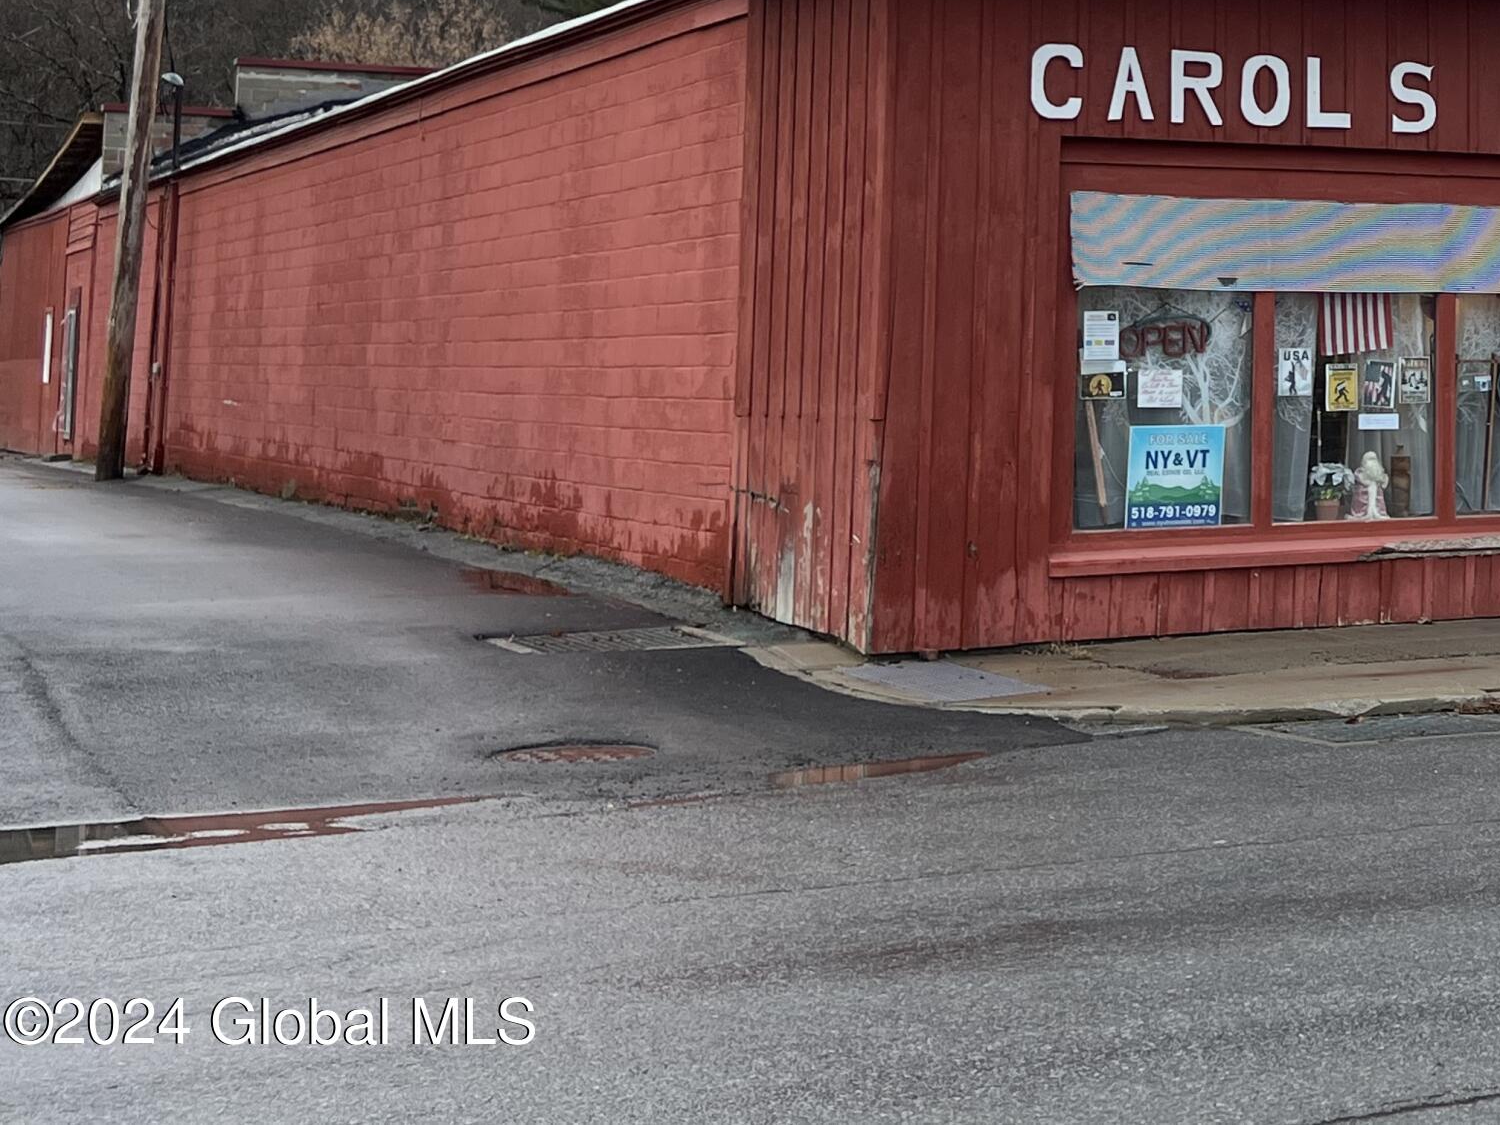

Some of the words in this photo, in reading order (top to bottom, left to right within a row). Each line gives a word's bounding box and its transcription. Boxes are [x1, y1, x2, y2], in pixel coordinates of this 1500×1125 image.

[1120, 322, 1208, 358] OPEN
[1283, 350, 1310, 361] USA
[1149, 433, 1175, 445] FOR
[1177, 431, 1209, 445] SALE
[1131, 504, 1216, 520] 518-791-0979
